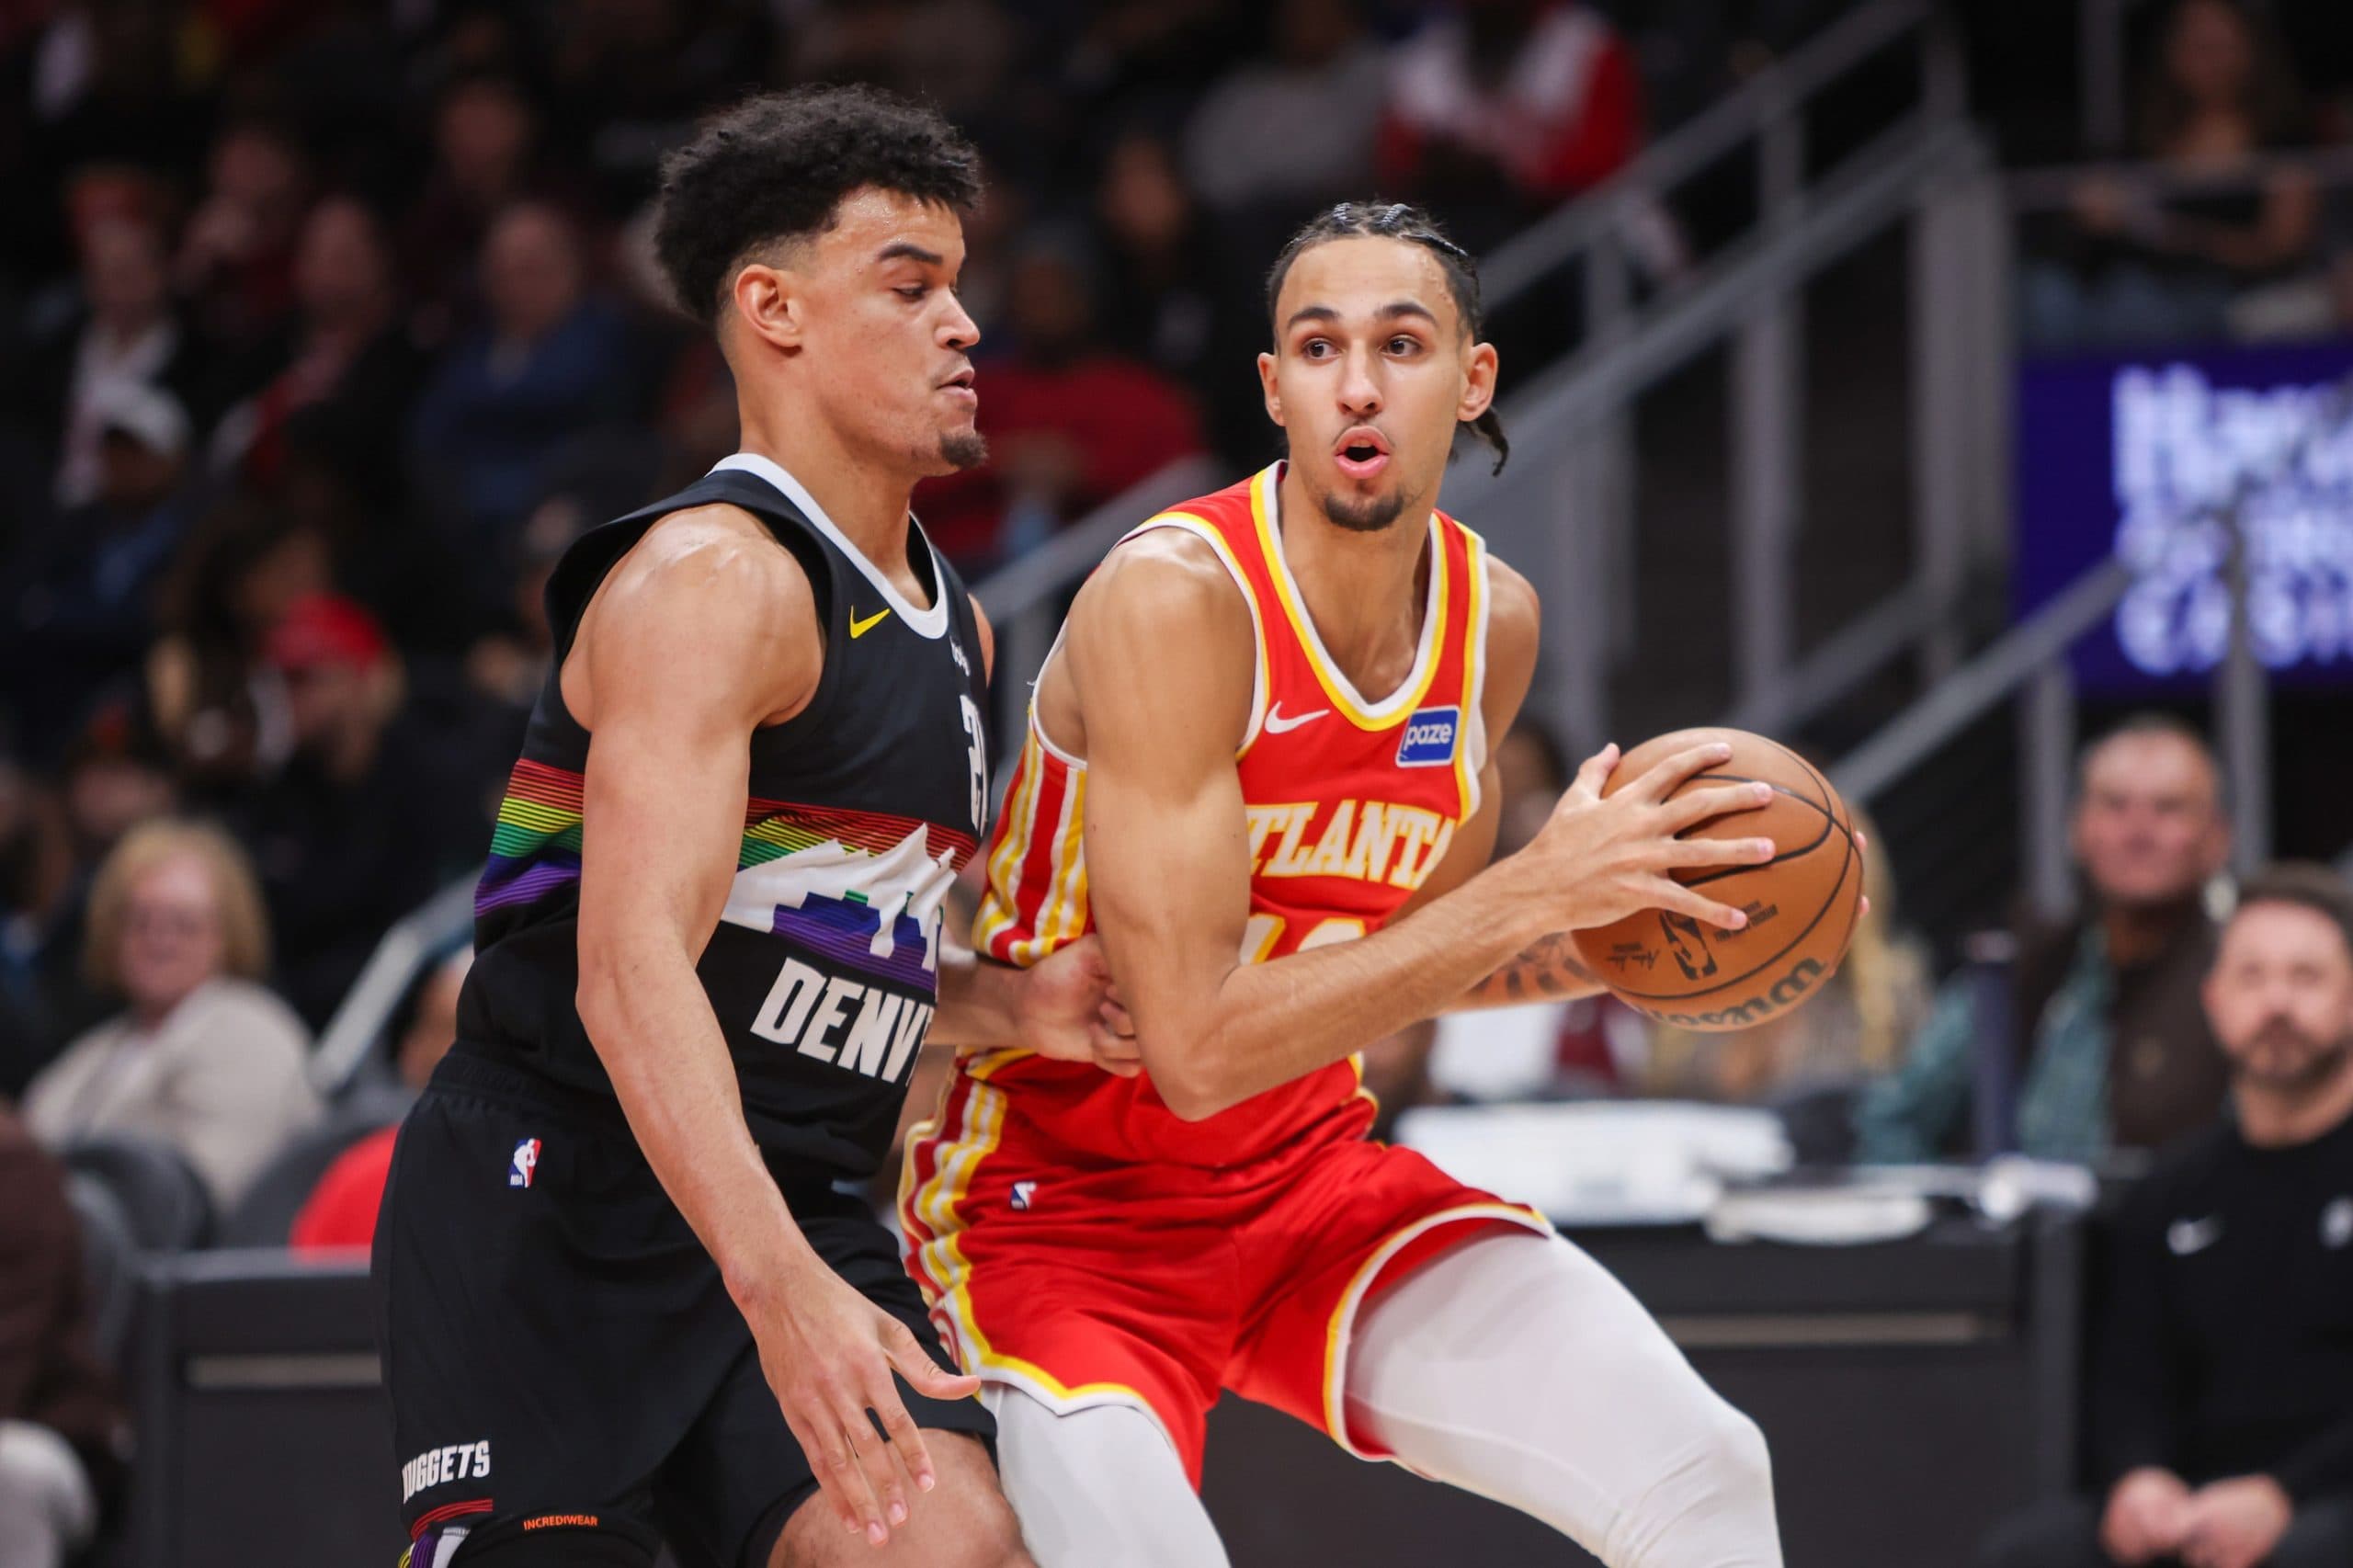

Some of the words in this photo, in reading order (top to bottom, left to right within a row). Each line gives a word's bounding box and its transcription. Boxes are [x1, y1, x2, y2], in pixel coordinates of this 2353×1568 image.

[960, 694, 988, 838] 2
[1404, 723, 1453, 752] paze
[1245, 798, 1456, 891] TLANT
[402, 1440, 491, 1505] NUGGETS
[523, 1514, 598, 1530] INCREDIWEAR
